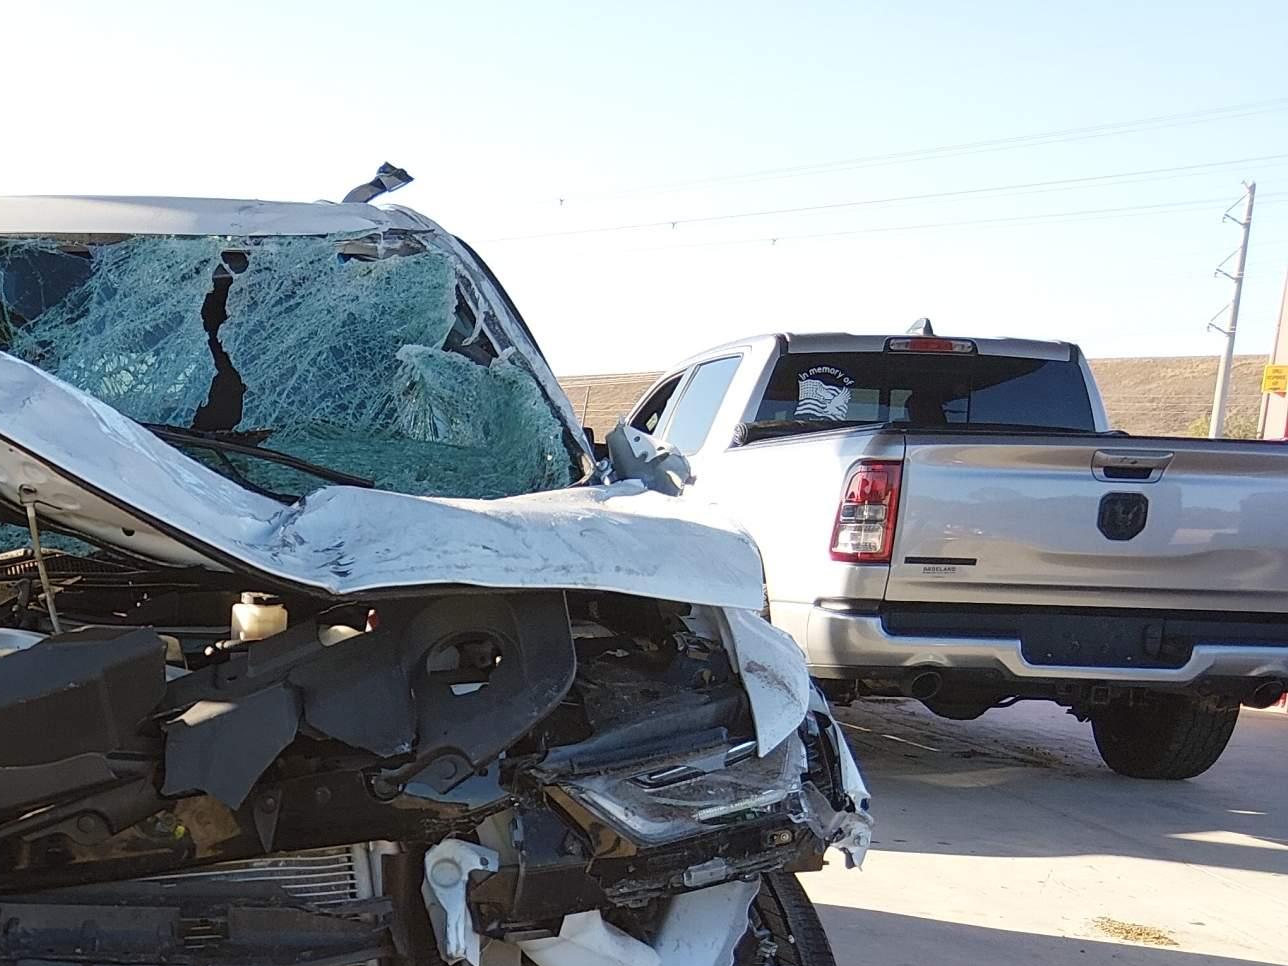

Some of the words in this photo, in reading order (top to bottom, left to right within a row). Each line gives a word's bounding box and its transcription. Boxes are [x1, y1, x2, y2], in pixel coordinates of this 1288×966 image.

[798, 372, 810, 381] In
[808, 366, 845, 379] memory
[843, 377, 855, 386] of
